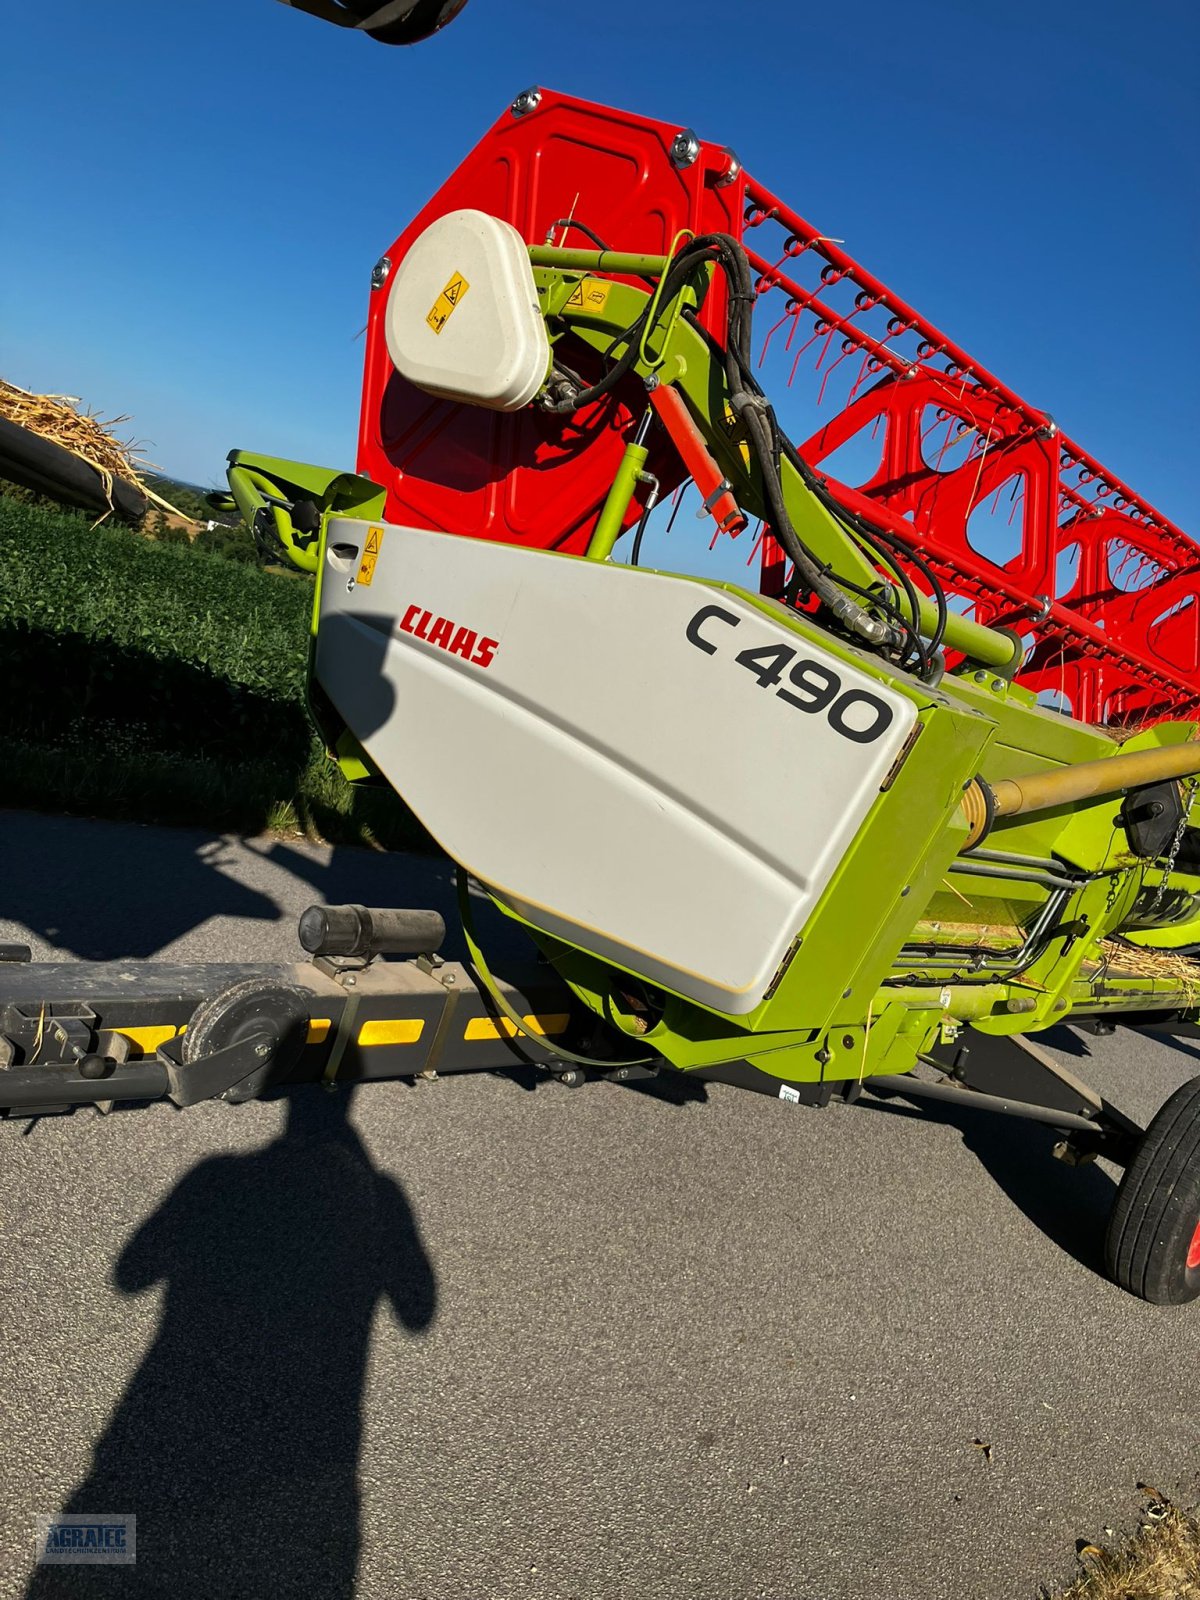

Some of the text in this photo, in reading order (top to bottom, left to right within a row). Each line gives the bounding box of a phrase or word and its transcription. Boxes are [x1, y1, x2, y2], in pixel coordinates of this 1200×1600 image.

[400, 604, 499, 668] CLAAS
[686, 604, 893, 744] C 490
